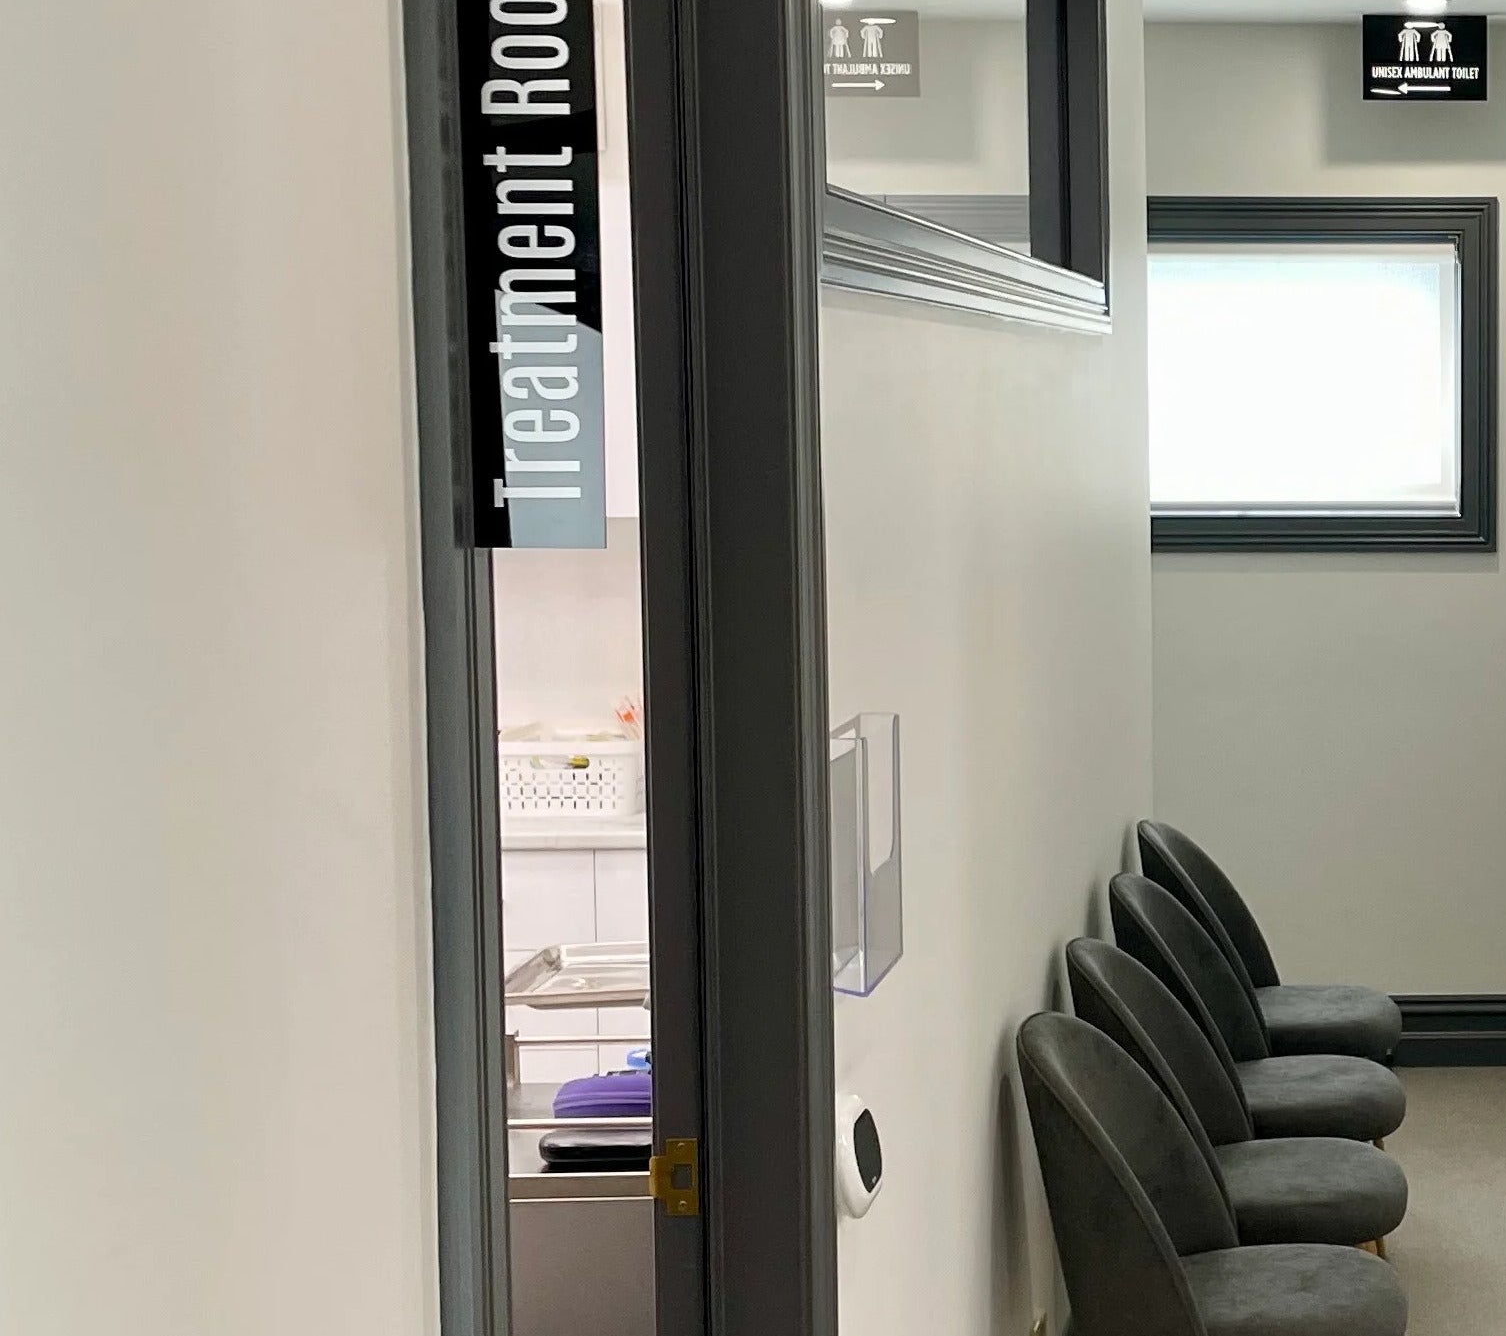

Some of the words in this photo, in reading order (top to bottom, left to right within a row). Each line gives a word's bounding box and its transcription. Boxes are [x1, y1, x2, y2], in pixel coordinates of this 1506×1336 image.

[1371, 66, 1403, 79] UNISEX
[1404, 66, 1451, 80] AMBULANT
[1452, 67, 1480, 80] TOILET
[484, 146, 582, 509] Treatment
